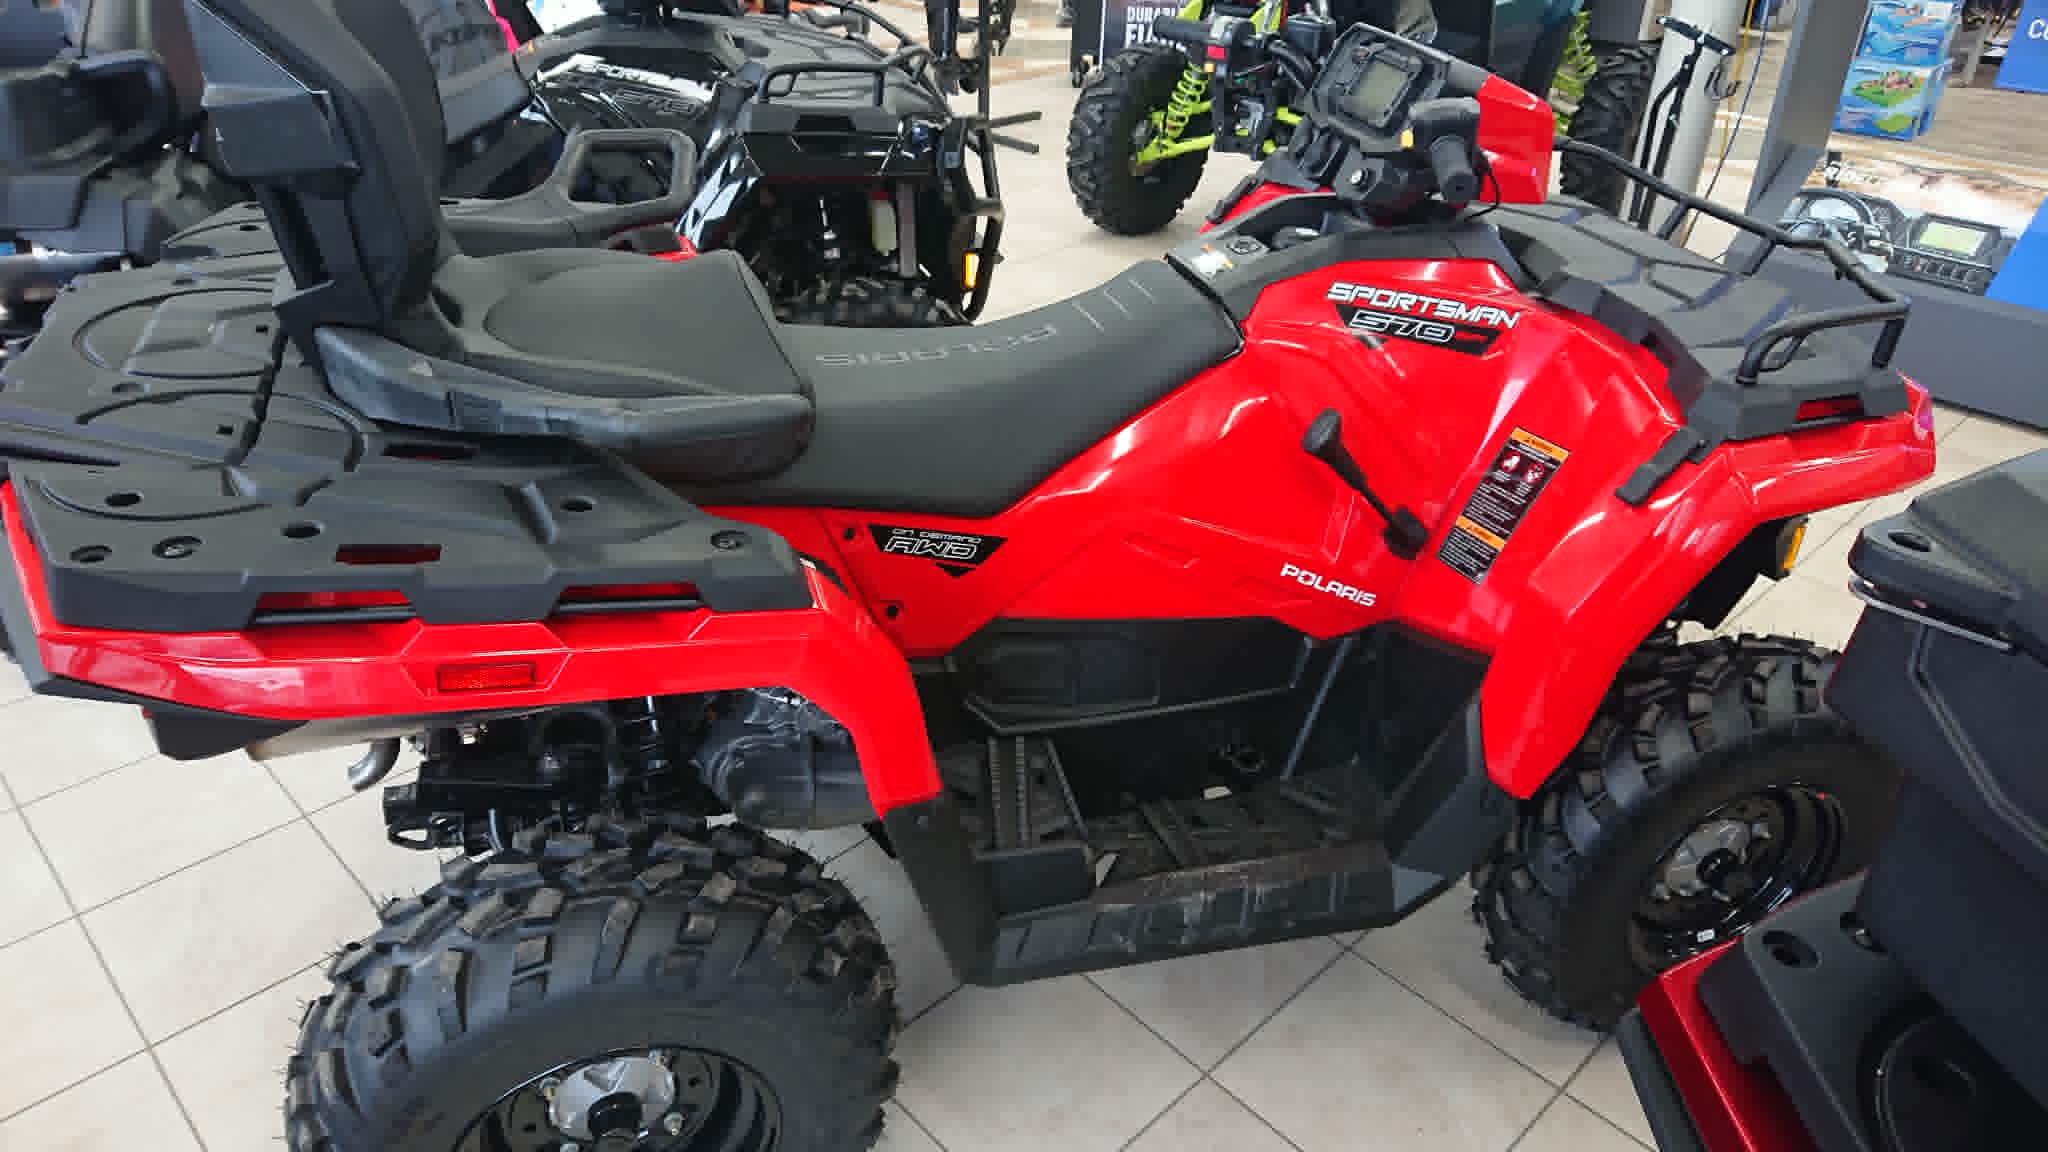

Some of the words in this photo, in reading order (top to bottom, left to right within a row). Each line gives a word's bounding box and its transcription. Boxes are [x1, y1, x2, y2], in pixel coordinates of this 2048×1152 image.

[1326, 281, 1521, 329] SPORTSMAN
[1348, 309, 1456, 343] 570
[815, 324, 1057, 368] POLARIS
[884, 536, 977, 559] AWD
[919, 531, 983, 543] DEMAND
[1281, 562, 1376, 607] POLARIS
